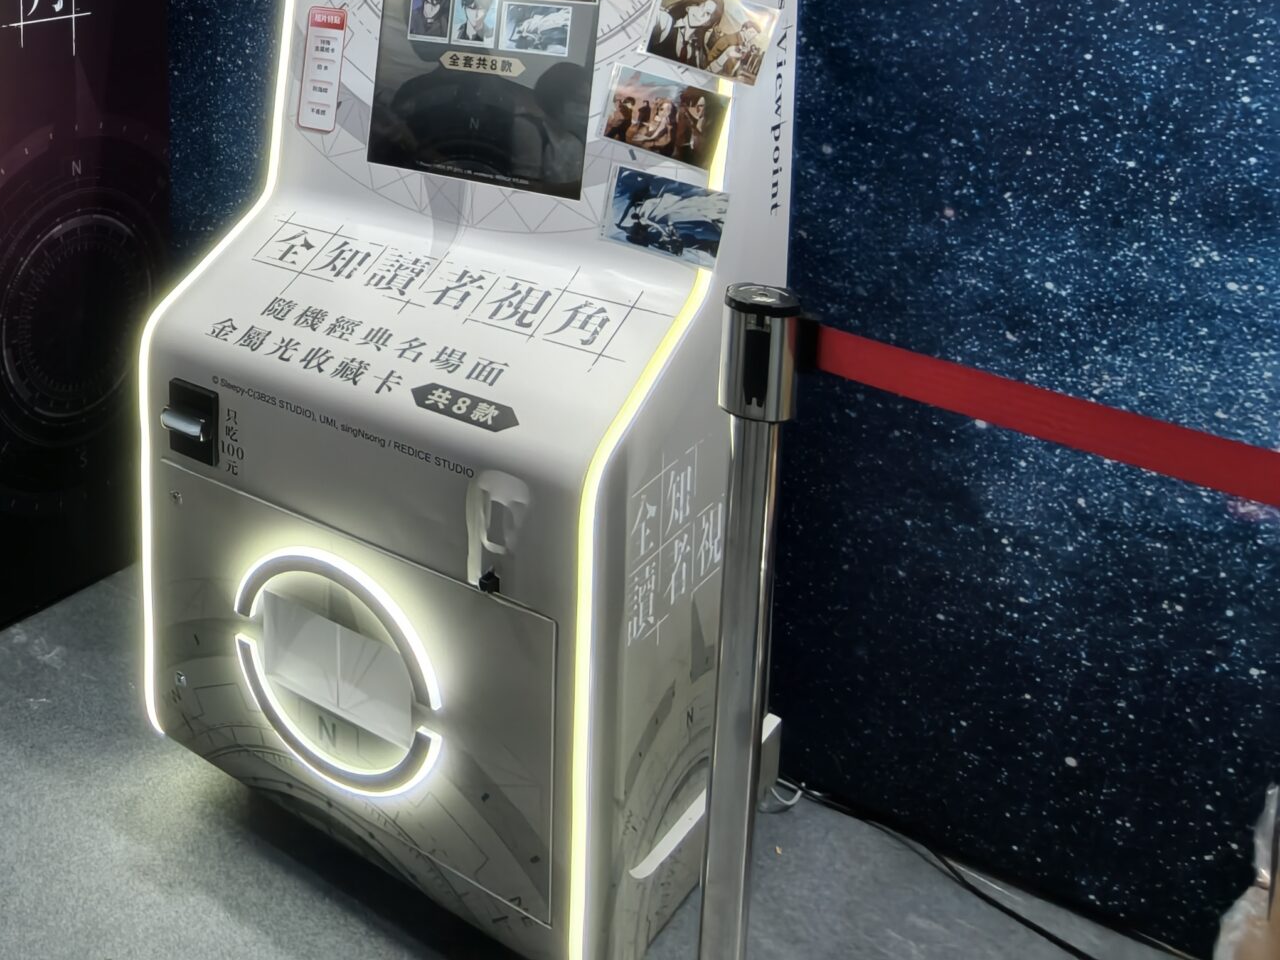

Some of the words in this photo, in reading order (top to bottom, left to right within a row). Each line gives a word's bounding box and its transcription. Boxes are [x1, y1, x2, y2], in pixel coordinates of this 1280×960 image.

[449, 53, 513, 73] 全套共8款
[769, 25, 791, 217] Viewpoint
[267, 230, 611, 346] 全知讀者視角
[205, 318, 405, 395] 金屬光收藏卡
[260, 296, 510, 387] 隨機經典名場面
[393, 441, 432, 464] REDICE
[434, 456, 475, 479] STUDIO
